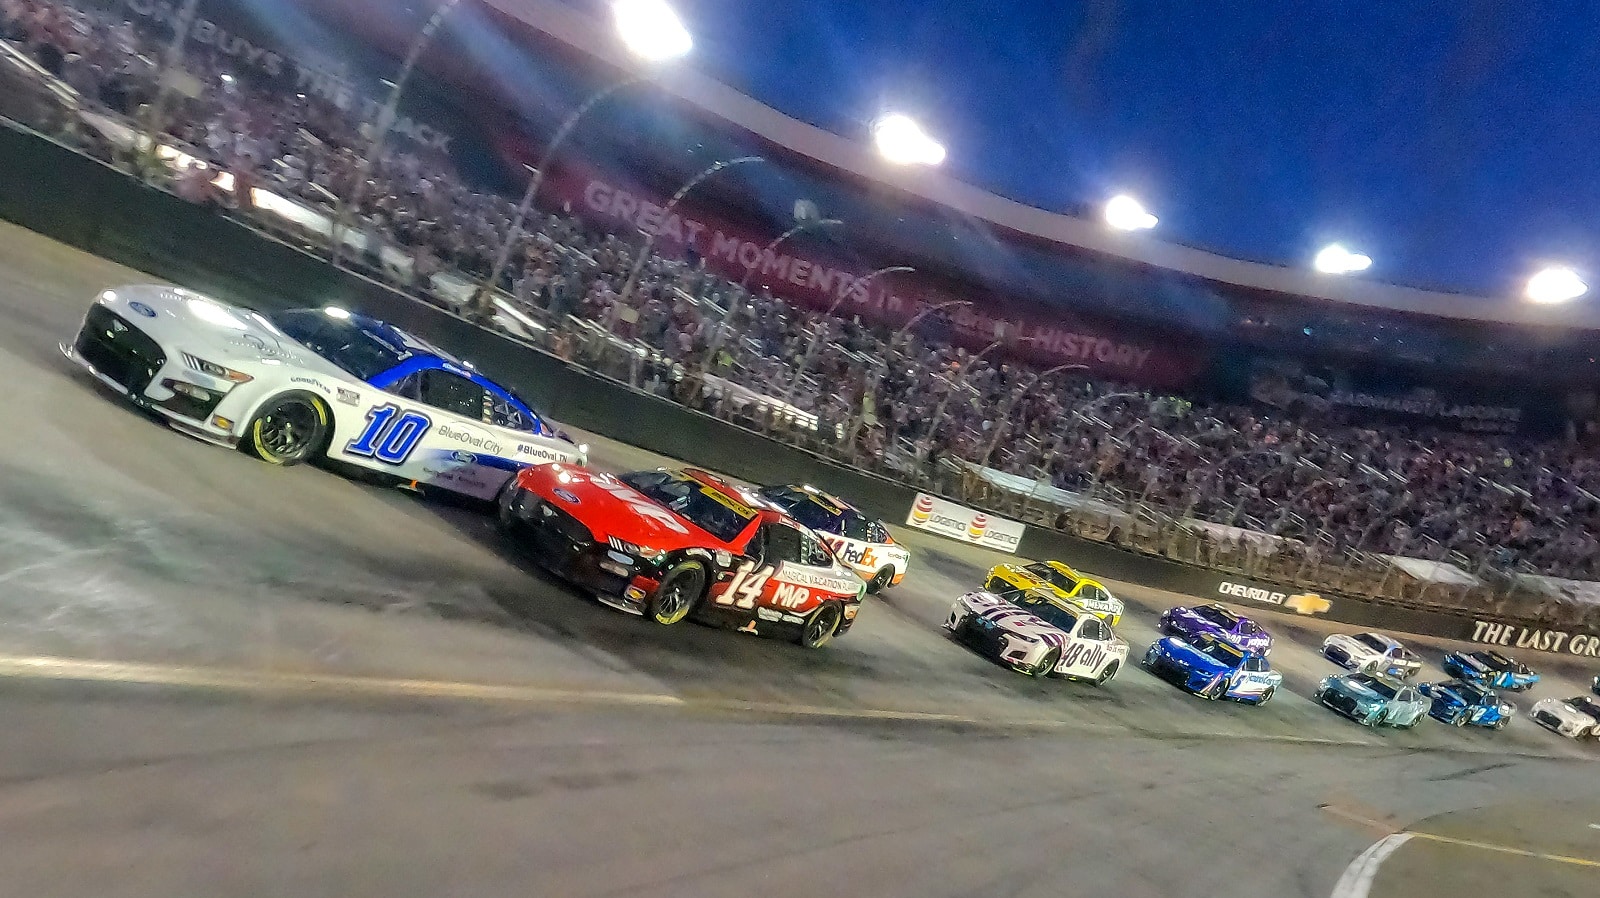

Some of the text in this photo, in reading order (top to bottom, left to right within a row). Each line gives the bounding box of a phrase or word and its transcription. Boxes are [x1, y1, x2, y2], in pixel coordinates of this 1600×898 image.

[585, 179, 706, 243] GREAT
[712, 230, 870, 304] MOMENTS
[1033, 327, 1152, 368] HISTORY
[345, 401, 432, 465] 10
[438, 425, 504, 456] BlueOval City
[930, 514, 967, 532] LOGISTICS
[985, 530, 1019, 545] LOGISTICS
[841, 542, 879, 569] FedEx
[715, 560, 775, 610] 14
[771, 581, 811, 610] MVP
[1218, 581, 1287, 605] CHEVROLET
[1471, 620, 1600, 657] THE LAST GR
[1061, 642, 1107, 673] 48 ally
